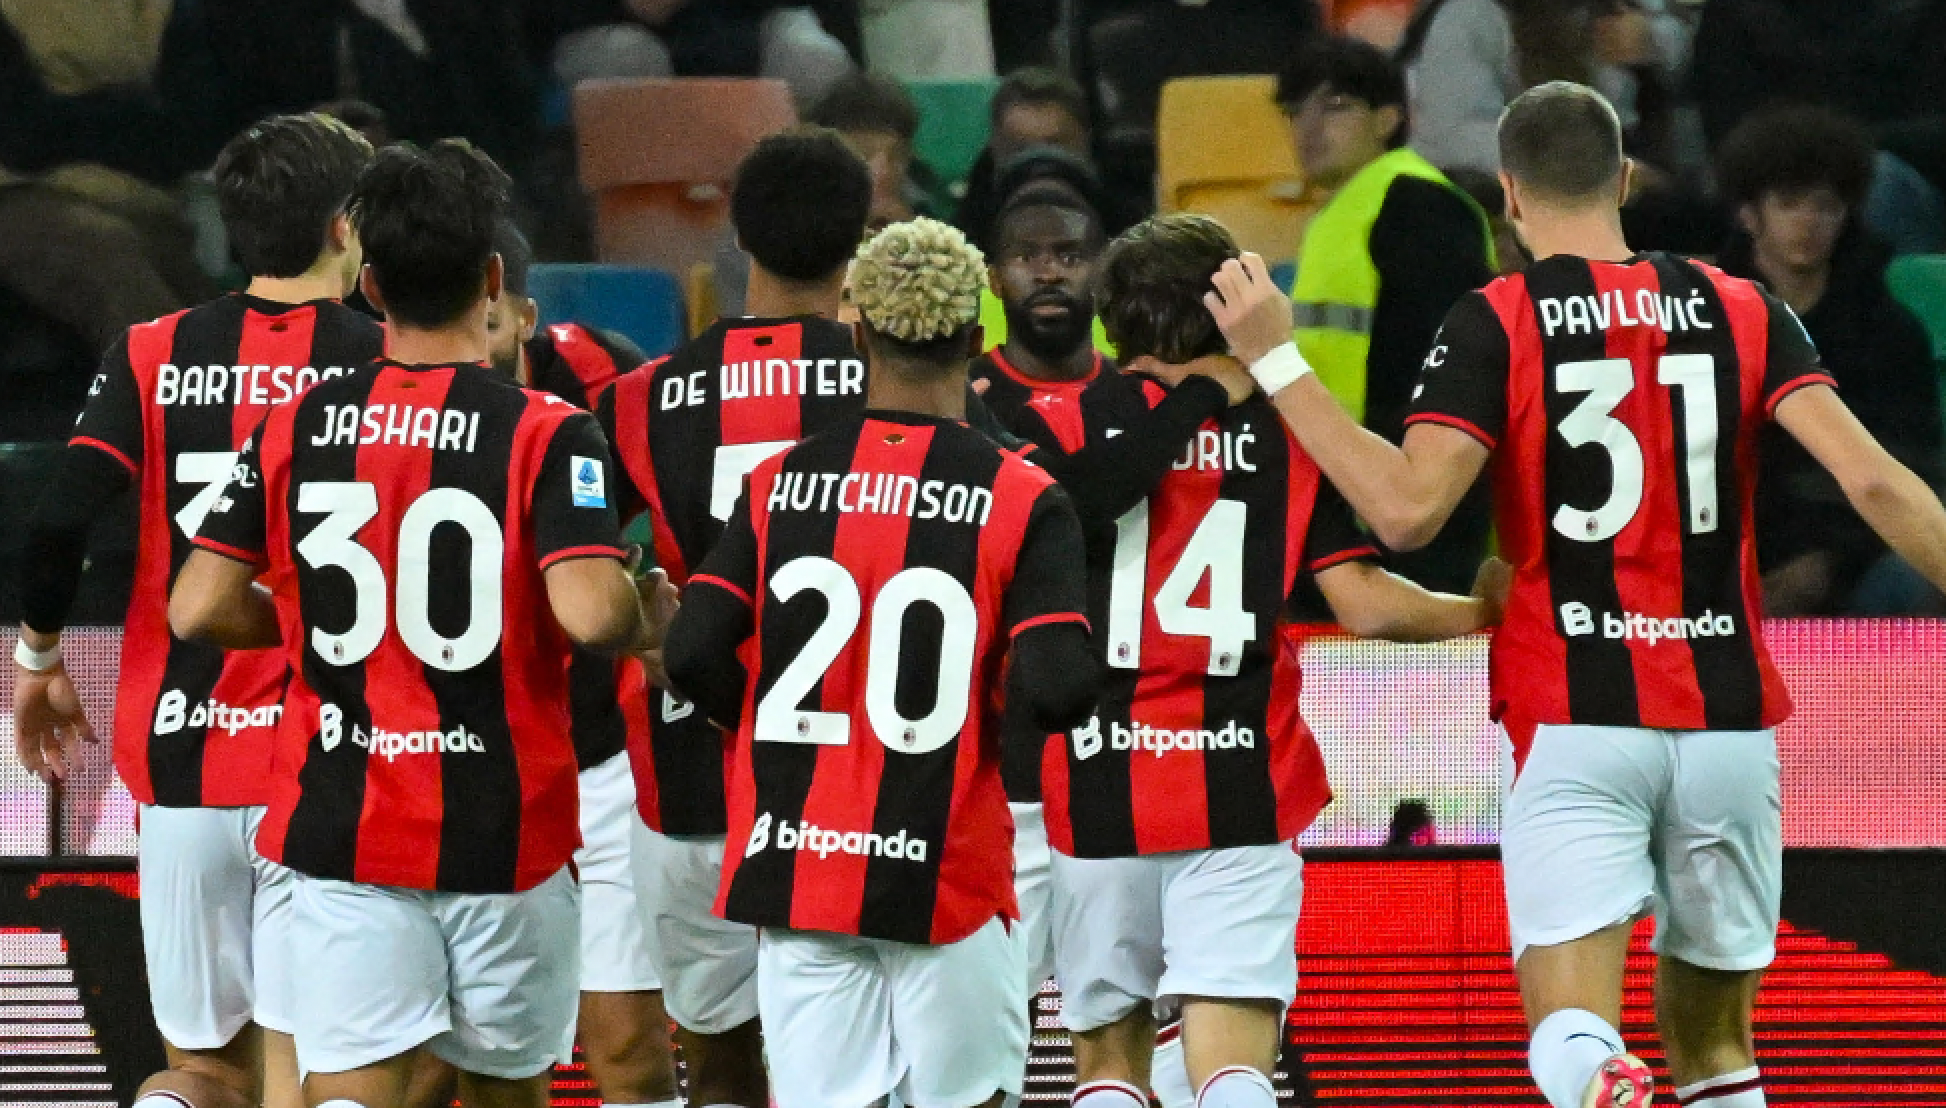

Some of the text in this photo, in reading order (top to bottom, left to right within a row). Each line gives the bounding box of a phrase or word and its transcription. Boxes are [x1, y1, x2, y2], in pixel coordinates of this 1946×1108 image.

[1539, 287, 1713, 337] PAVLOVIĆ
[156, 364, 356, 405] BARTESA
[661, 358, 865, 411] DE WINTER
[311, 404, 480, 453] JASHARI
[1552, 353, 1719, 542] 31
[767, 471, 993, 527] HUTCHINSON
[297, 481, 505, 672] 30
[1107, 496, 1257, 677] 14
[1603, 609, 1736, 647] bitpanda
[754, 555, 978, 755] 20
[187, 698, 284, 737] bitpan
[1111, 720, 1255, 759] bitpanda
[351, 723, 486, 763] bitpanda
[776, 819, 927, 862] bitpanda
